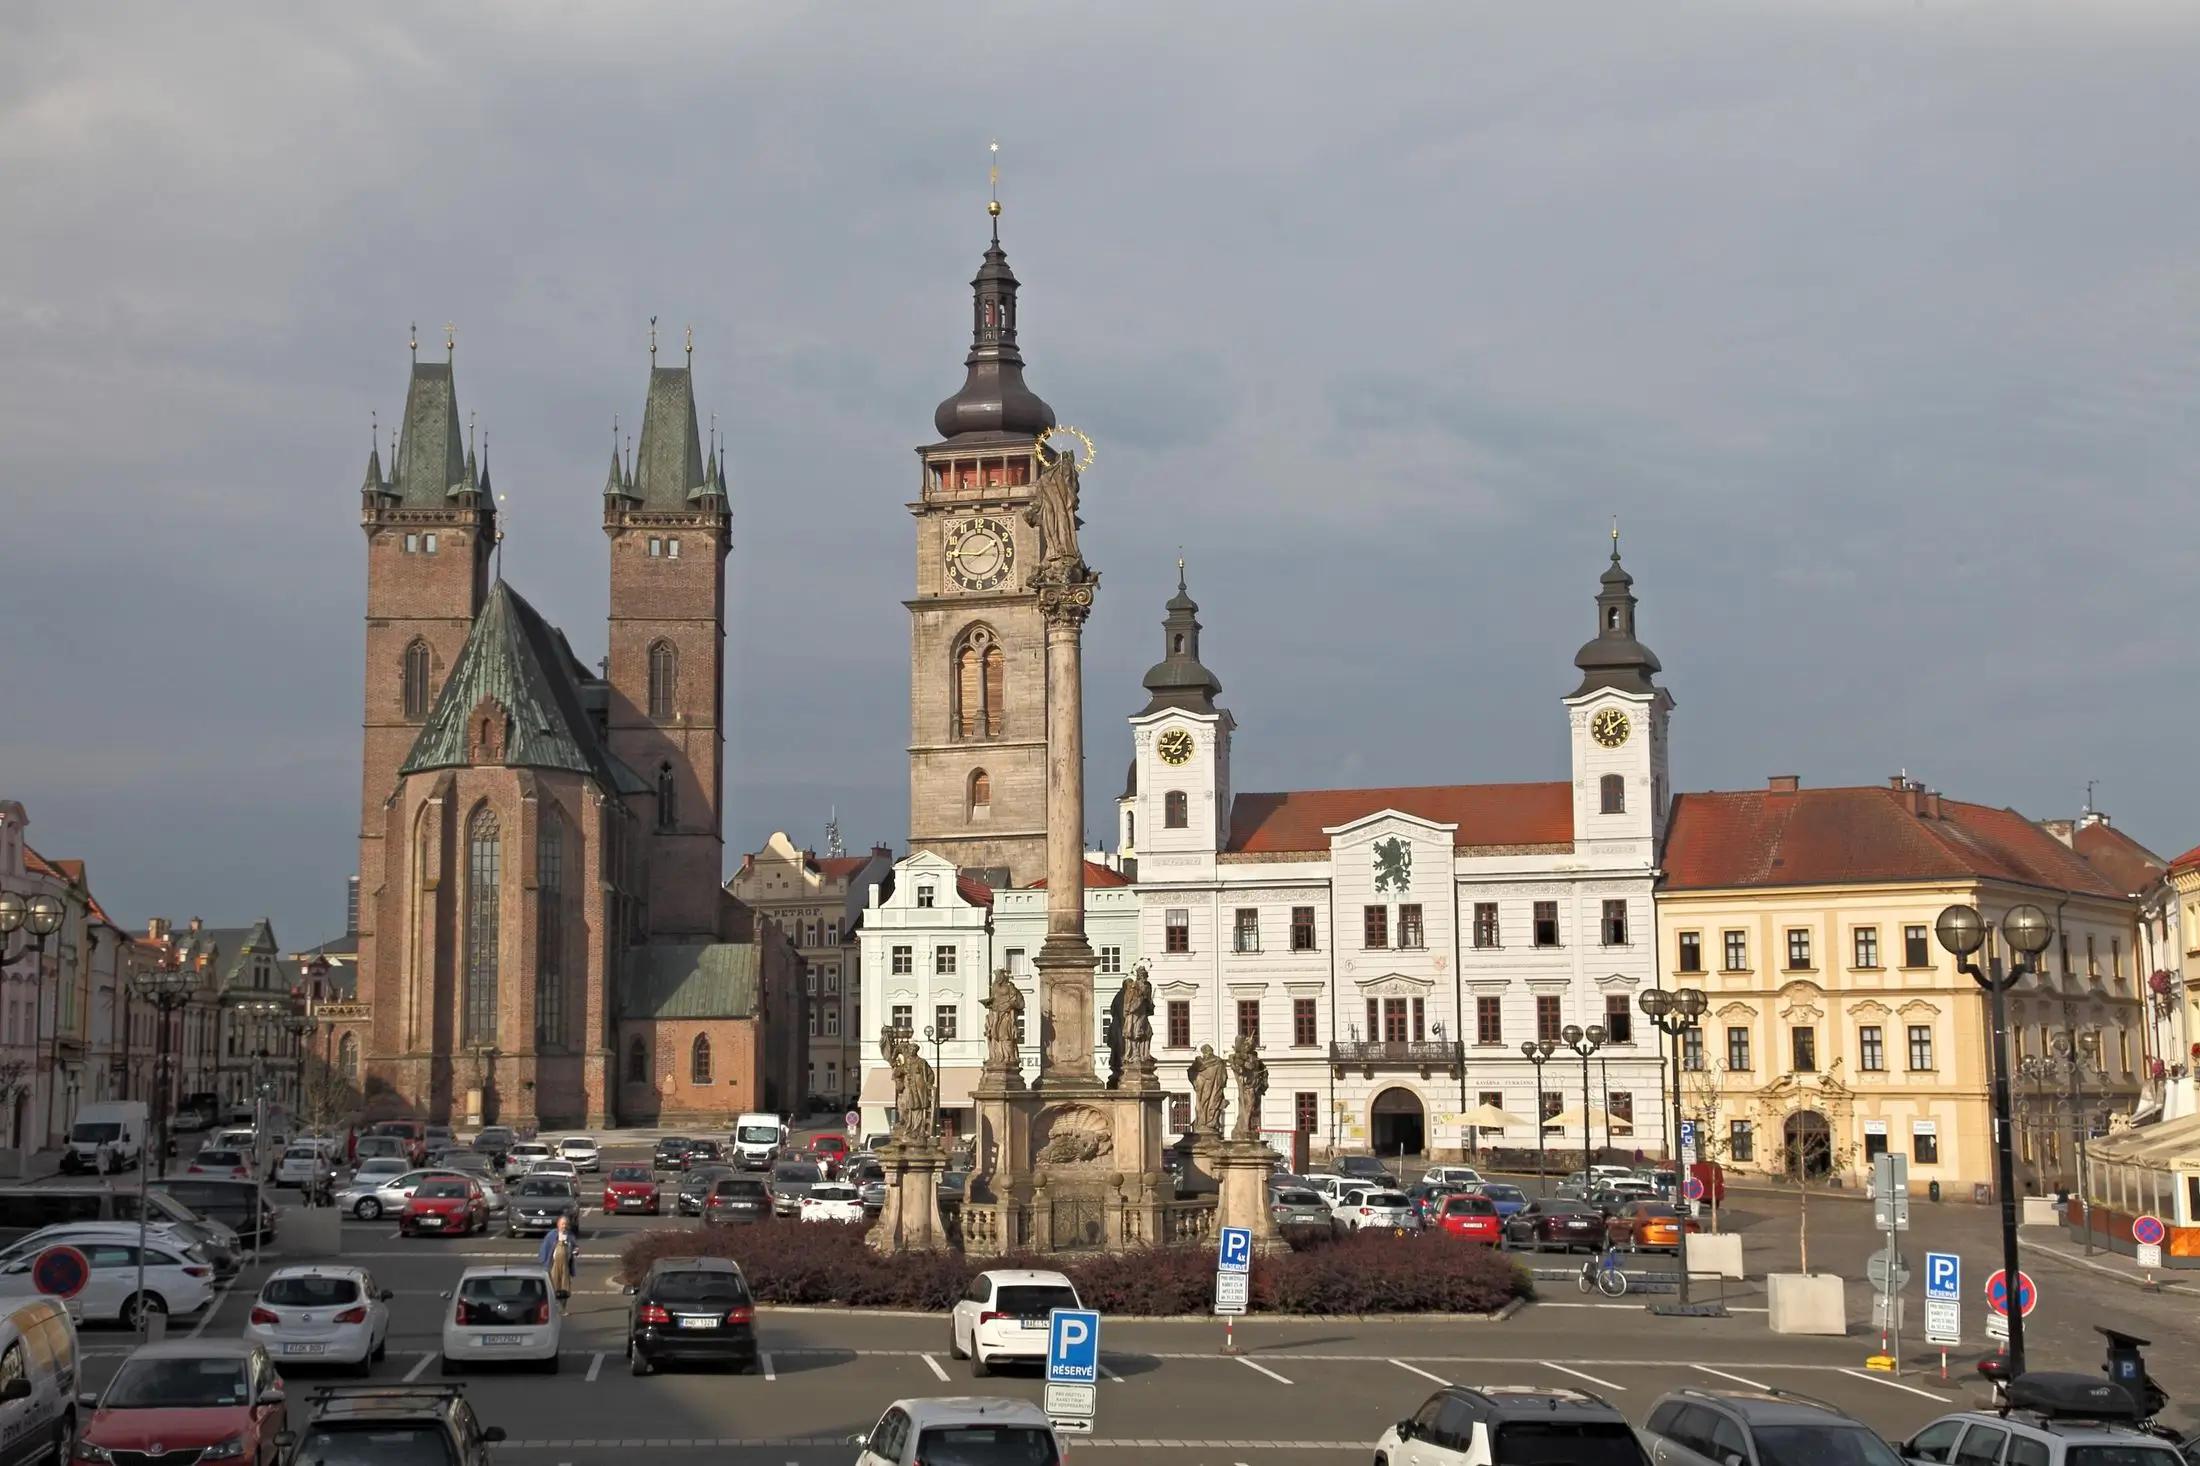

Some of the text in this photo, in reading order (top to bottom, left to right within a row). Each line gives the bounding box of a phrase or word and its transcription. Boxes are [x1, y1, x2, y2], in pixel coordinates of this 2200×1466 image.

[974, 518, 984, 528] 12
[992, 522, 996, 532] 1
[960, 524, 968, 534] 11
[950, 536, 958, 546] 10
[1002, 532, 1008, 542] 2
[946, 551, 952, 561] 9
[1006, 548, 1012, 558] 3
[950, 567, 956, 576] 8
[1002, 563, 1009, 572] 4
[962, 578, 968, 586] 7
[976, 580, 982, 590] 6
[992, 576, 998, 584] 5
[1228, 1232, 1246, 1258] P
[1237, 1252, 1246, 1262] 4x
[1935, 1258, 1954, 1284] P
[1060, 1320, 1088, 1359] P
[1052, 1364, 1092, 1376] RÉSERVÉ
[2123, 1362, 2134, 1376] P
